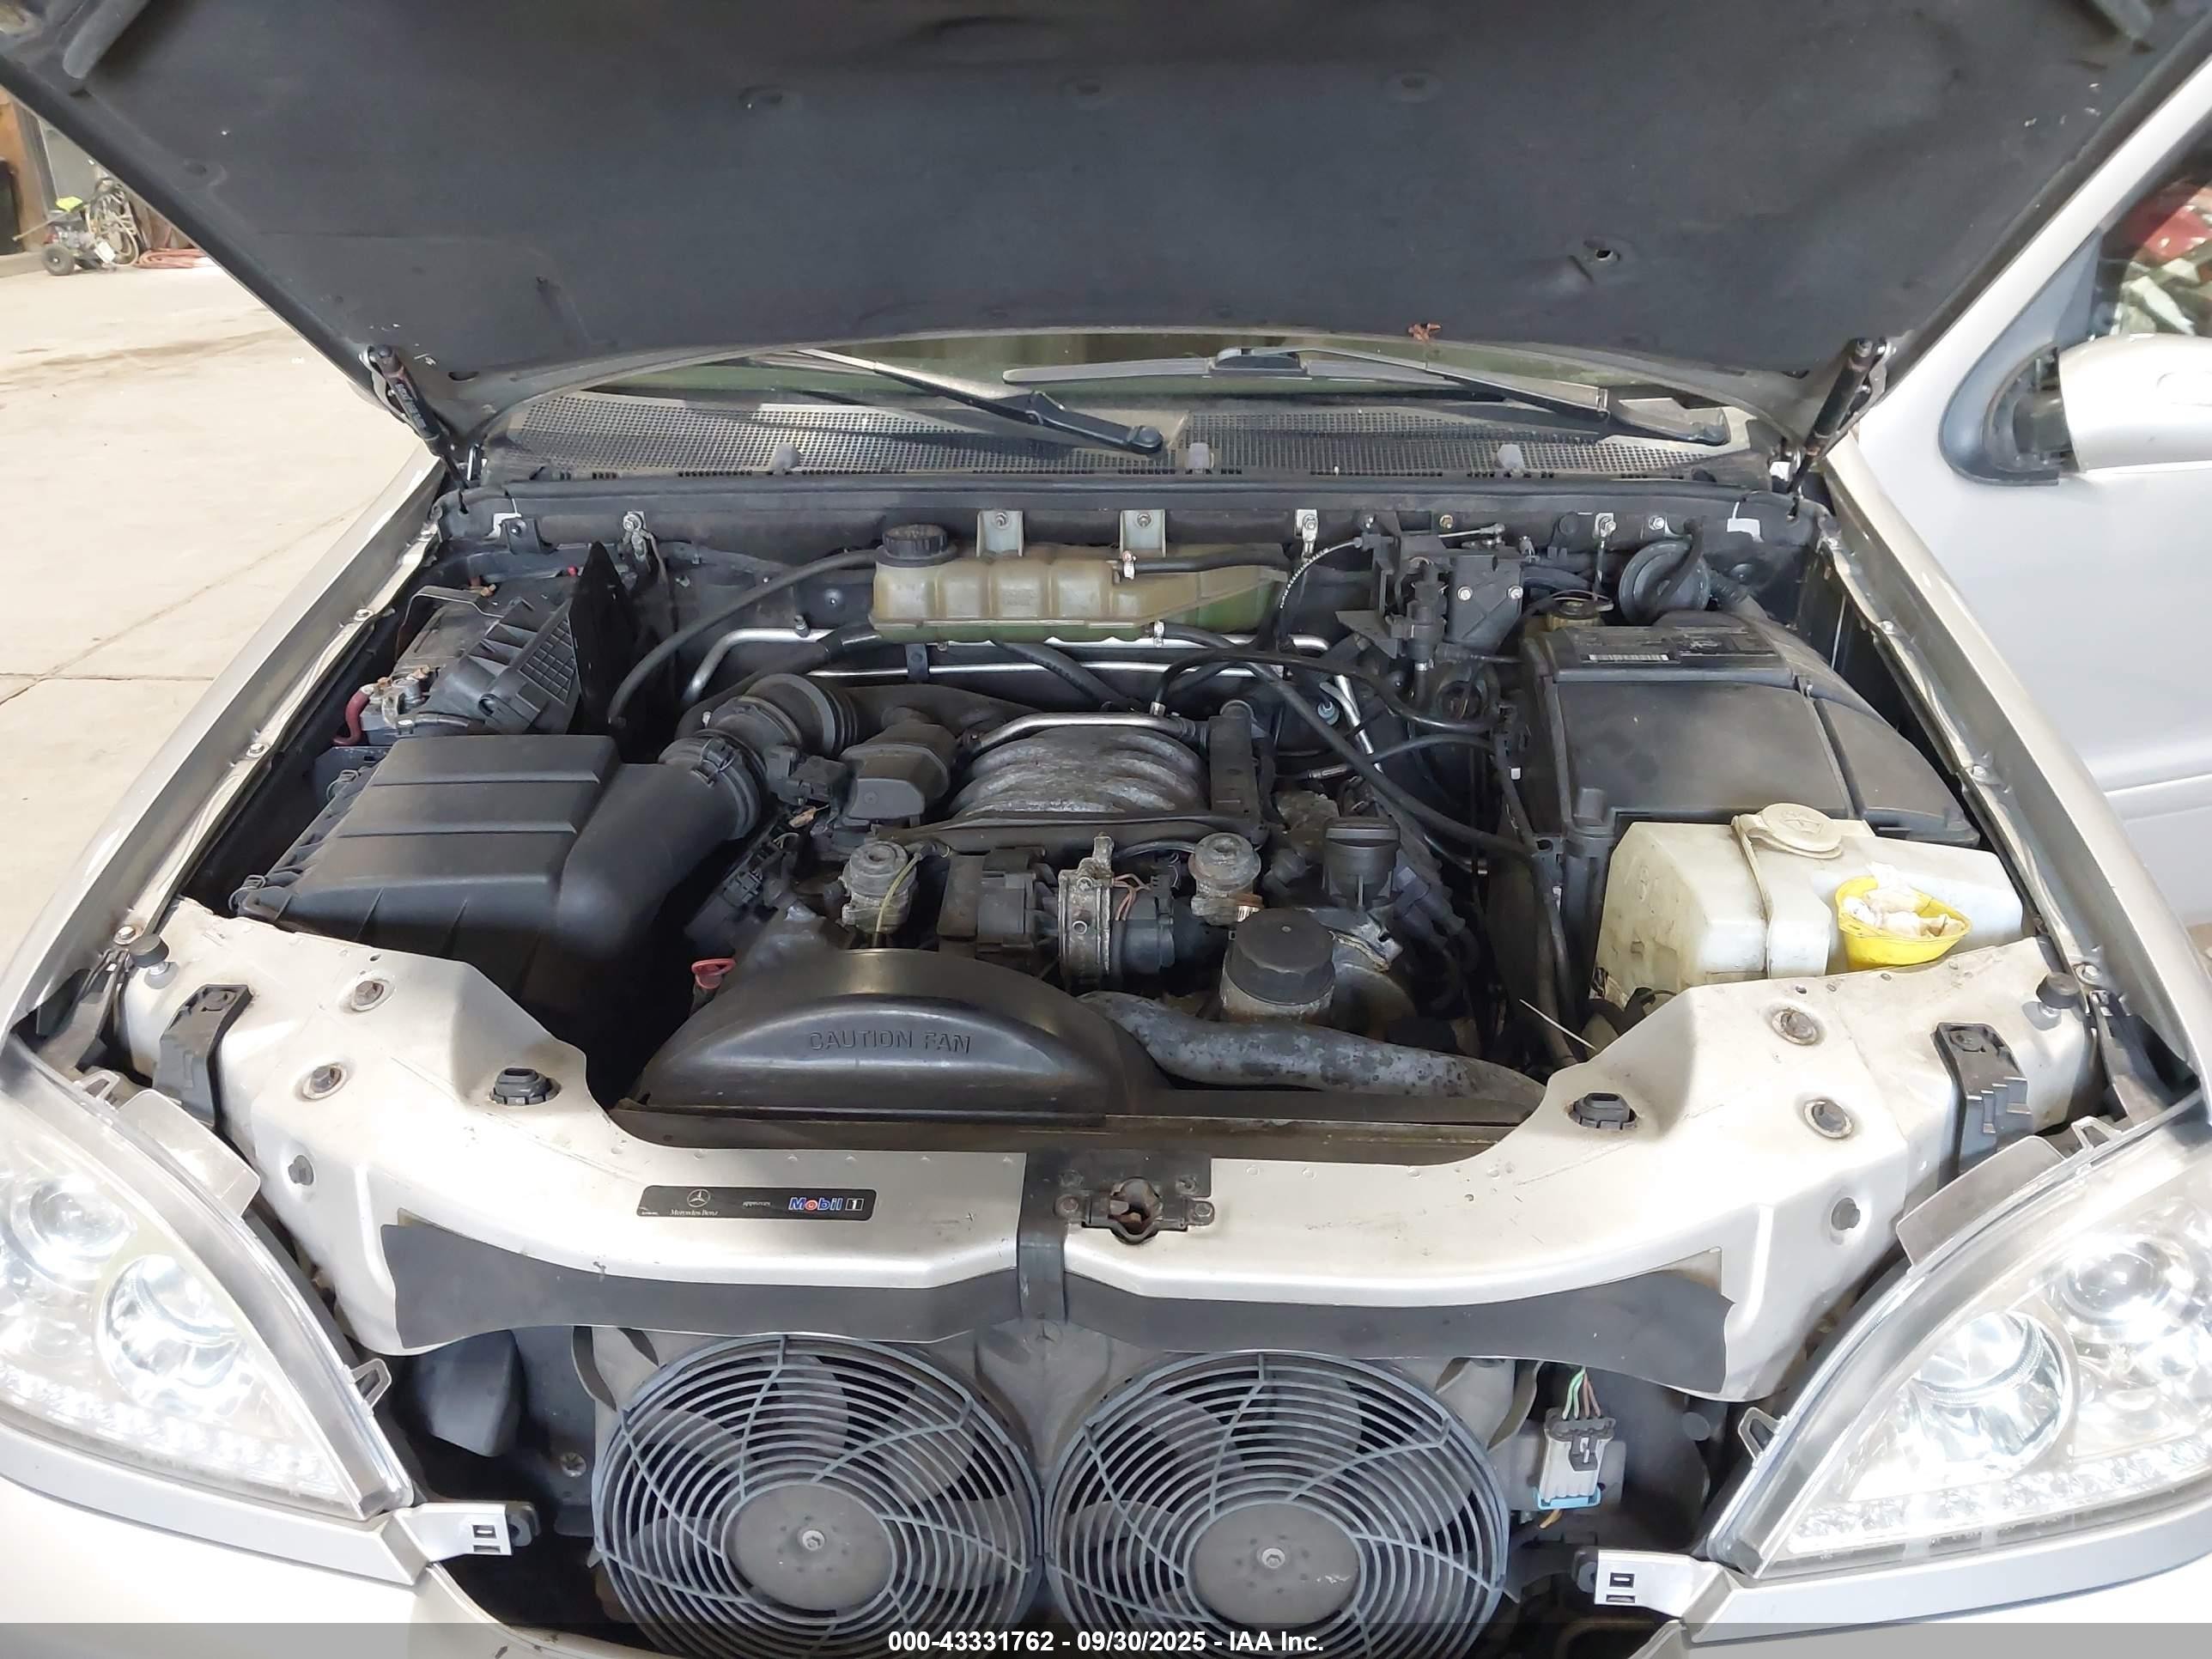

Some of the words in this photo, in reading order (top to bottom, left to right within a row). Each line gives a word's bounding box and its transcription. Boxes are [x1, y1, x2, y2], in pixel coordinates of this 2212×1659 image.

[810, 1030, 912, 1050] CAUTION
[925, 1032, 970, 1054] FAN
[670, 1208, 720, 1217] MercedesBenz
[788, 1197, 842, 1213] Mobil
